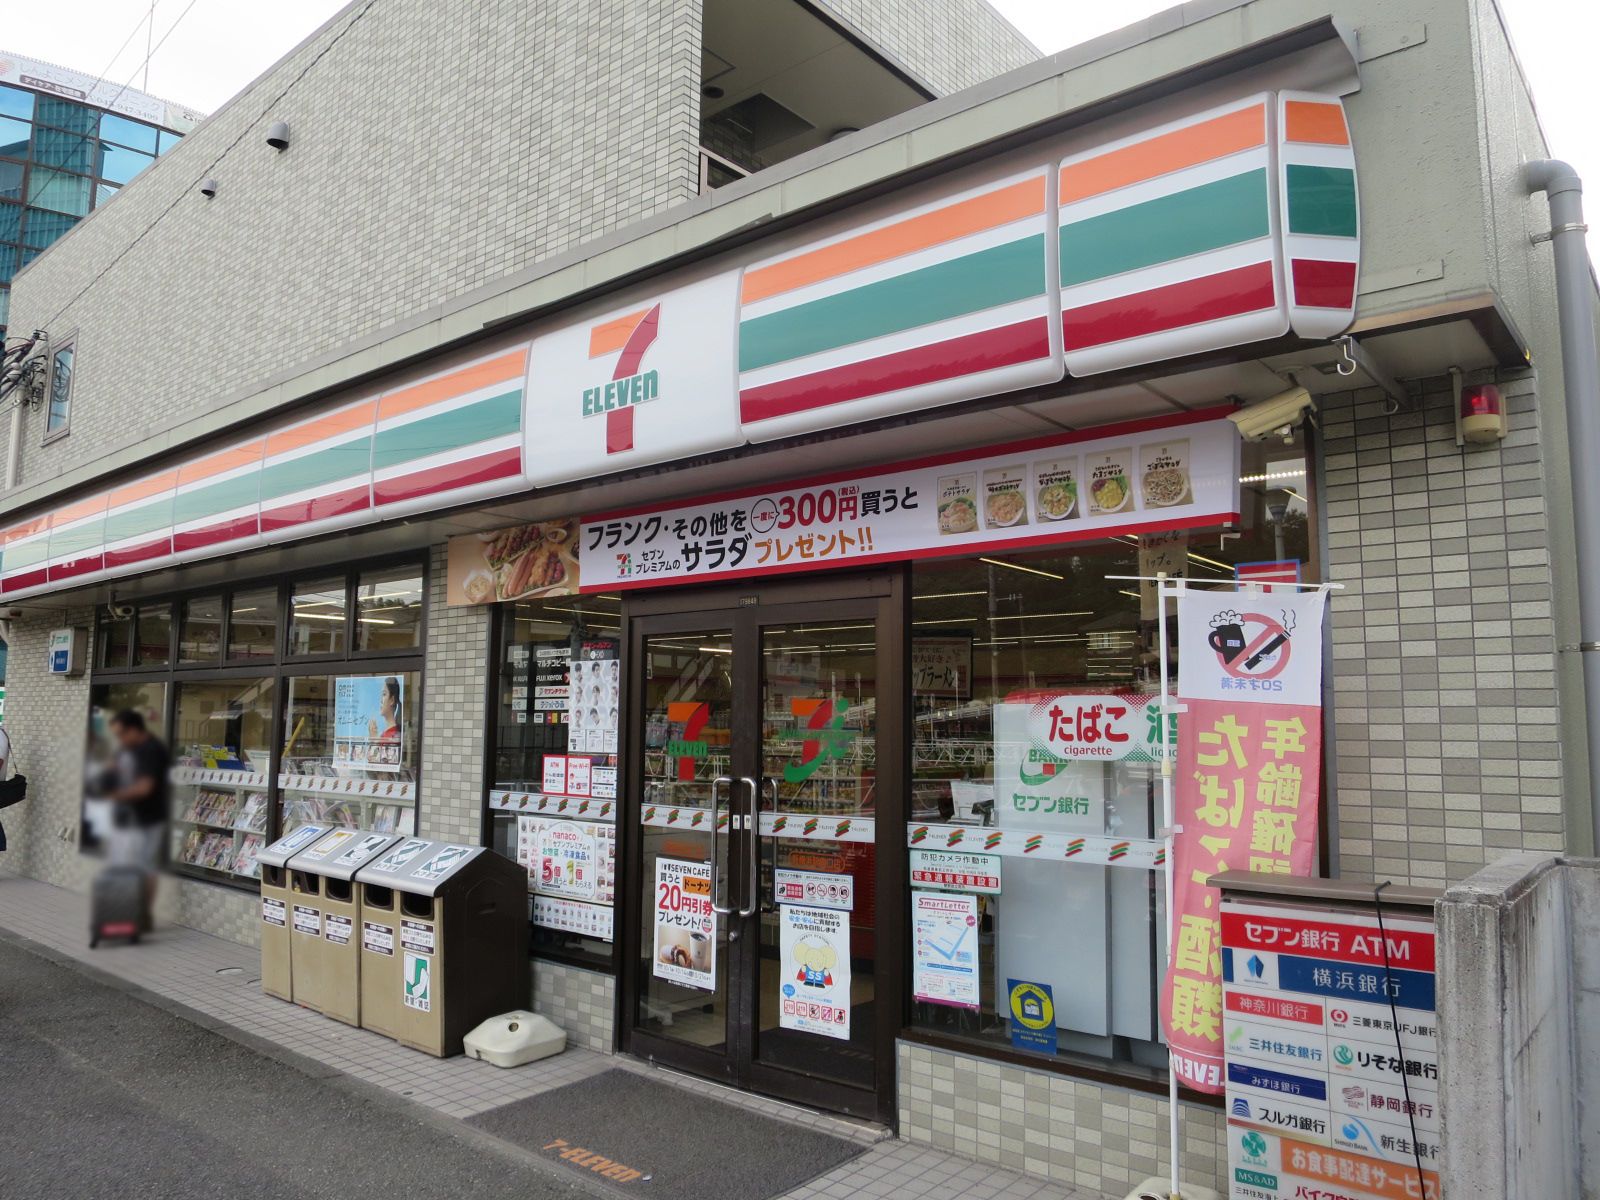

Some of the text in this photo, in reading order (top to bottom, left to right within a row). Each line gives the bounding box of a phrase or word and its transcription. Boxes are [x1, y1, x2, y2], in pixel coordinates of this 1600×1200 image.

[635, 559, 681, 575] プレミアムの
[681, 533, 752, 572] サラダ
[641, 549, 666, 562] セブン
[1048, 704, 1129, 743] たばこ
[1064, 746, 1113, 756] cigarette
[1013, 793, 1089, 815] セブン銀行
[671, 863, 692, 874] SEVEN
[921, 853, 989, 866] 防犯カメラ作動中
[660, 872, 680, 884] 買うと
[918, 898, 971, 911] SmartLetter
[658, 911, 701, 930] プレゼント!
[1245, 921, 1410, 960] セブン銀行 ATM
[1312, 968, 1402, 998] 横浜銀行
[1239, 996, 1309, 1020] 神奈川銀行
[1249, 1038, 1323, 1061] 三井住友銀行
[1357, 1051, 1438, 1080] りそな銀行
[1251, 1076, 1301, 1094] みずほ銀行
[1370, 1094, 1433, 1119] 静岡銀行
[1259, 1107, 1326, 1134] スルガ銀行
[1238, 1171, 1275, 1186] MS&AD
